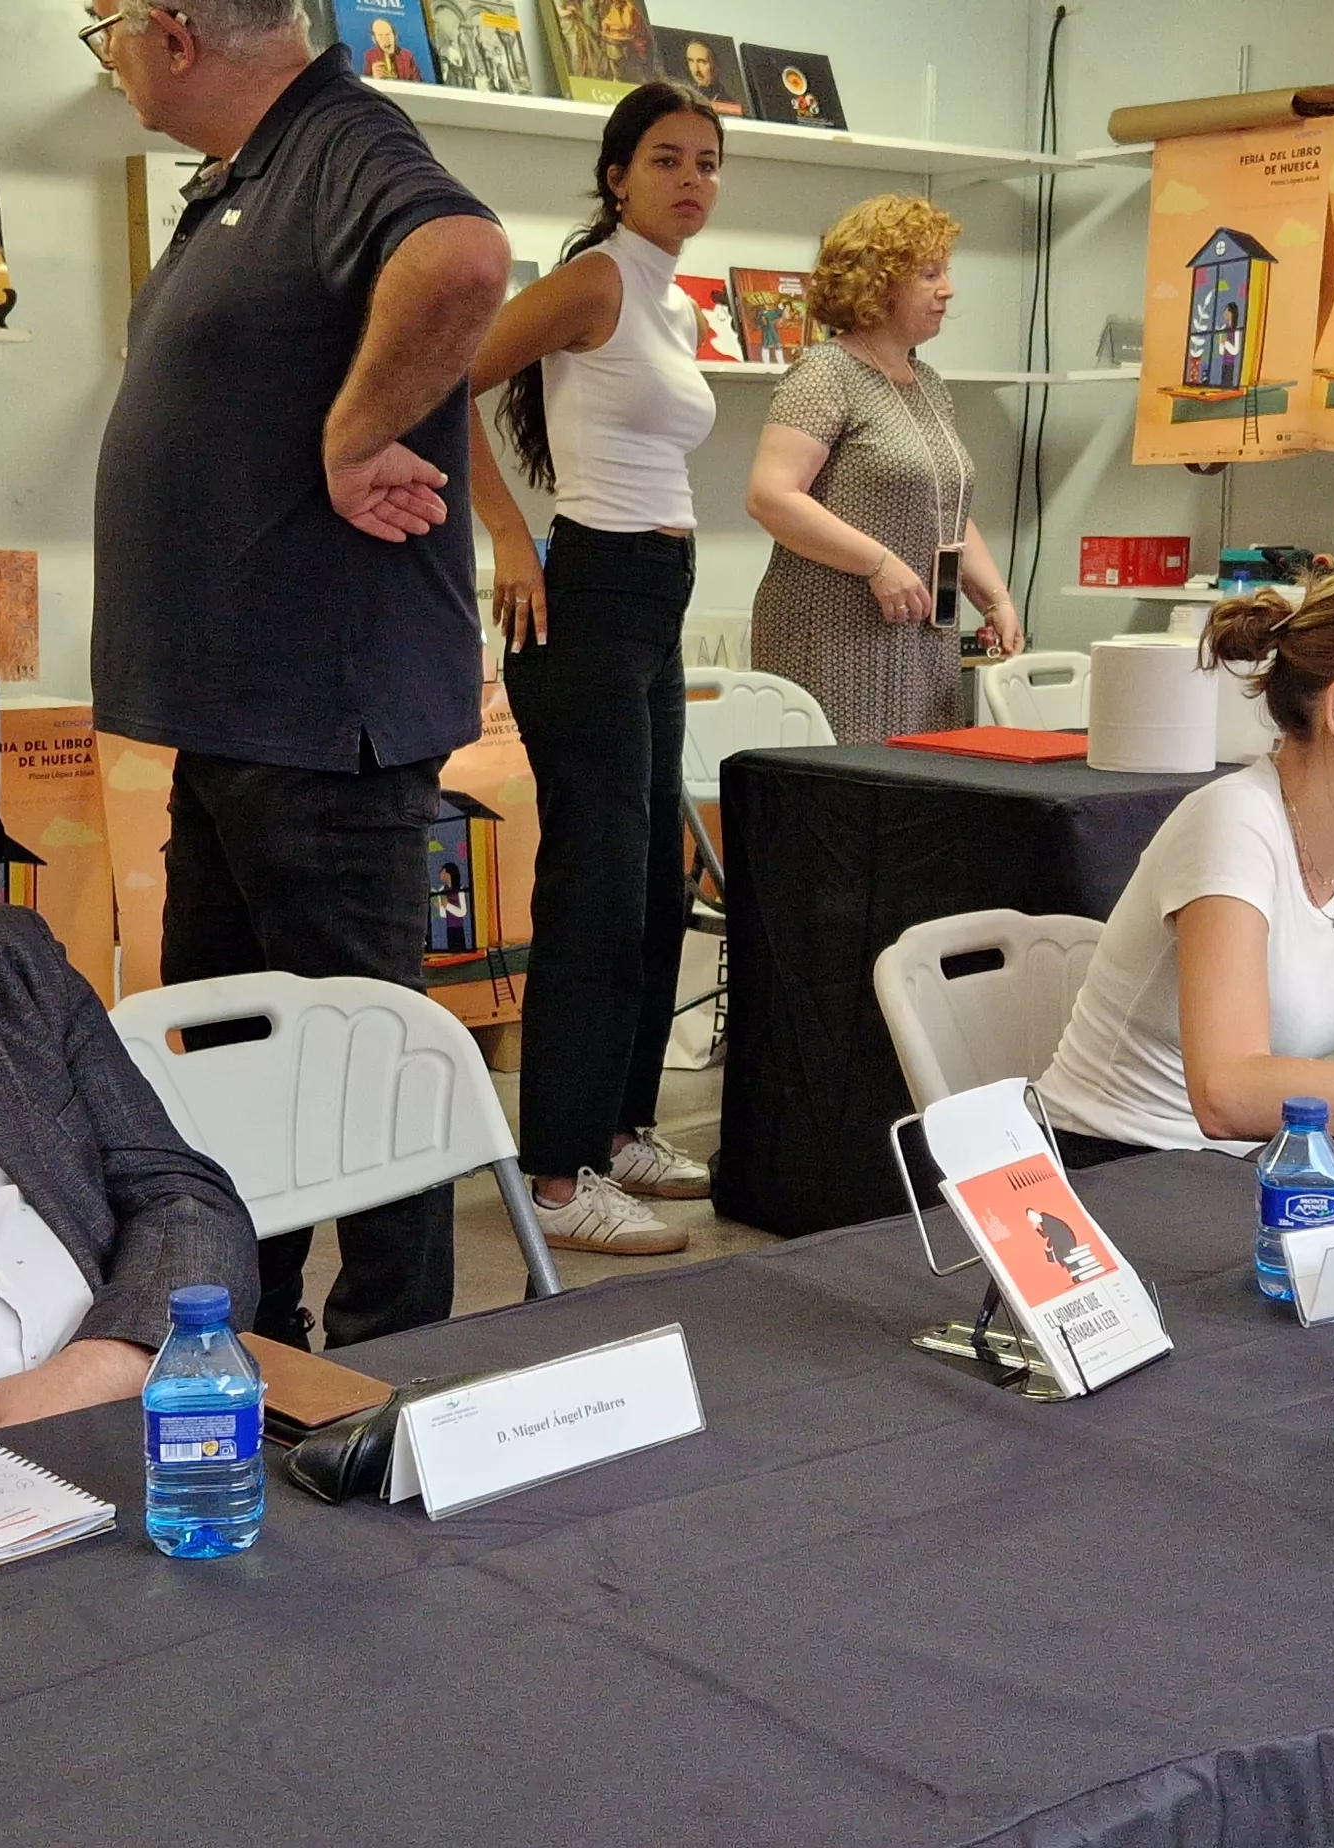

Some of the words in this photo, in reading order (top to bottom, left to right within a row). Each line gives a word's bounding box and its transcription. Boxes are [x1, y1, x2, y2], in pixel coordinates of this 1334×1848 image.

[1239, 154, 1265, 166] FERIA
[1269, 150, 1287, 161] DEL
[1291, 146, 1322, 159] LIBRO
[1264, 165, 1277, 176] DE
[1280, 160, 1320, 174] HUESCA
[482, 724, 518, 737] HUESC
[24, 739, 48, 751] DEL
[54, 737, 93, 750] LIBRO
[19, 755, 36, 768] DE
[41, 753, 93, 767] HUESCA
[1043, 1312, 1056, 1330] EL
[1053, 1298, 1089, 1325] HOMBRE
[1082, 1292, 1103, 1311] QUE
[1098, 1309, 1121, 1330] LEER
[1056, 1315, 1100, 1350] ESEÑABA
[1093, 1316, 1105, 1332] A
[496, 1431, 511, 1444] D.
[512, 1417, 550, 1437] Miguel
[552, 1409, 583, 1428] Ángel
